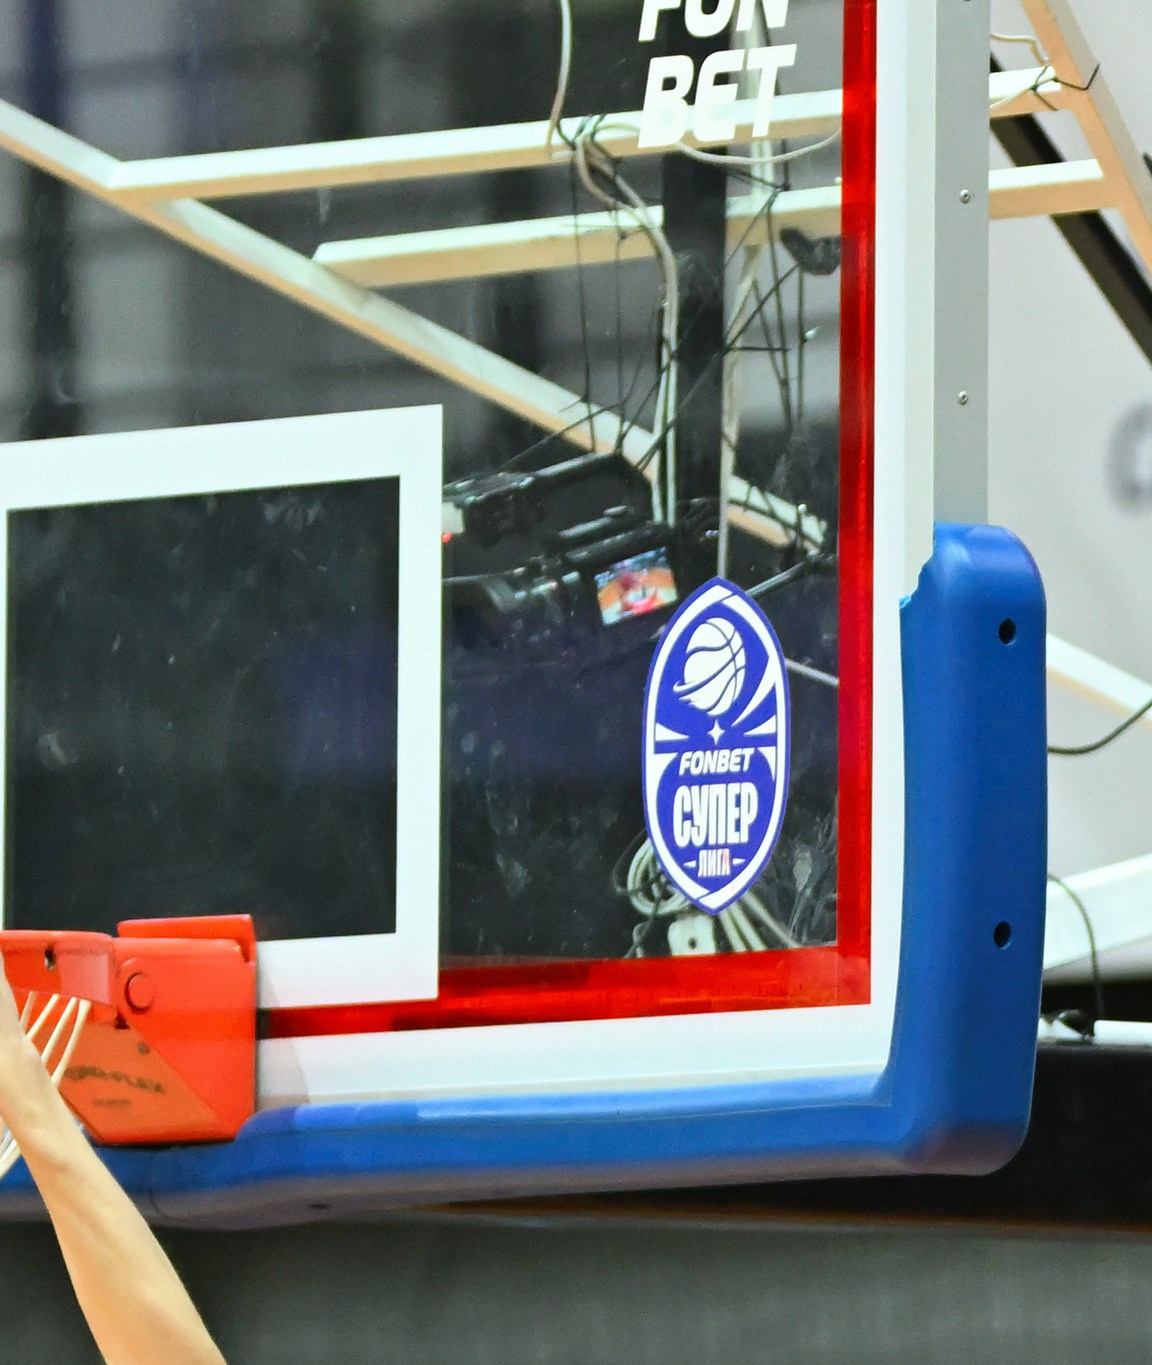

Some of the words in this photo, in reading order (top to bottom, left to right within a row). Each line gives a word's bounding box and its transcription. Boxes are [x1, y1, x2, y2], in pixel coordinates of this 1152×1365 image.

[638, 44, 797, 148] BET
[679, 748, 755, 776] FONBET
[673, 782, 759, 848] СУПЕР
[698, 848, 730, 877] ЛИГА
